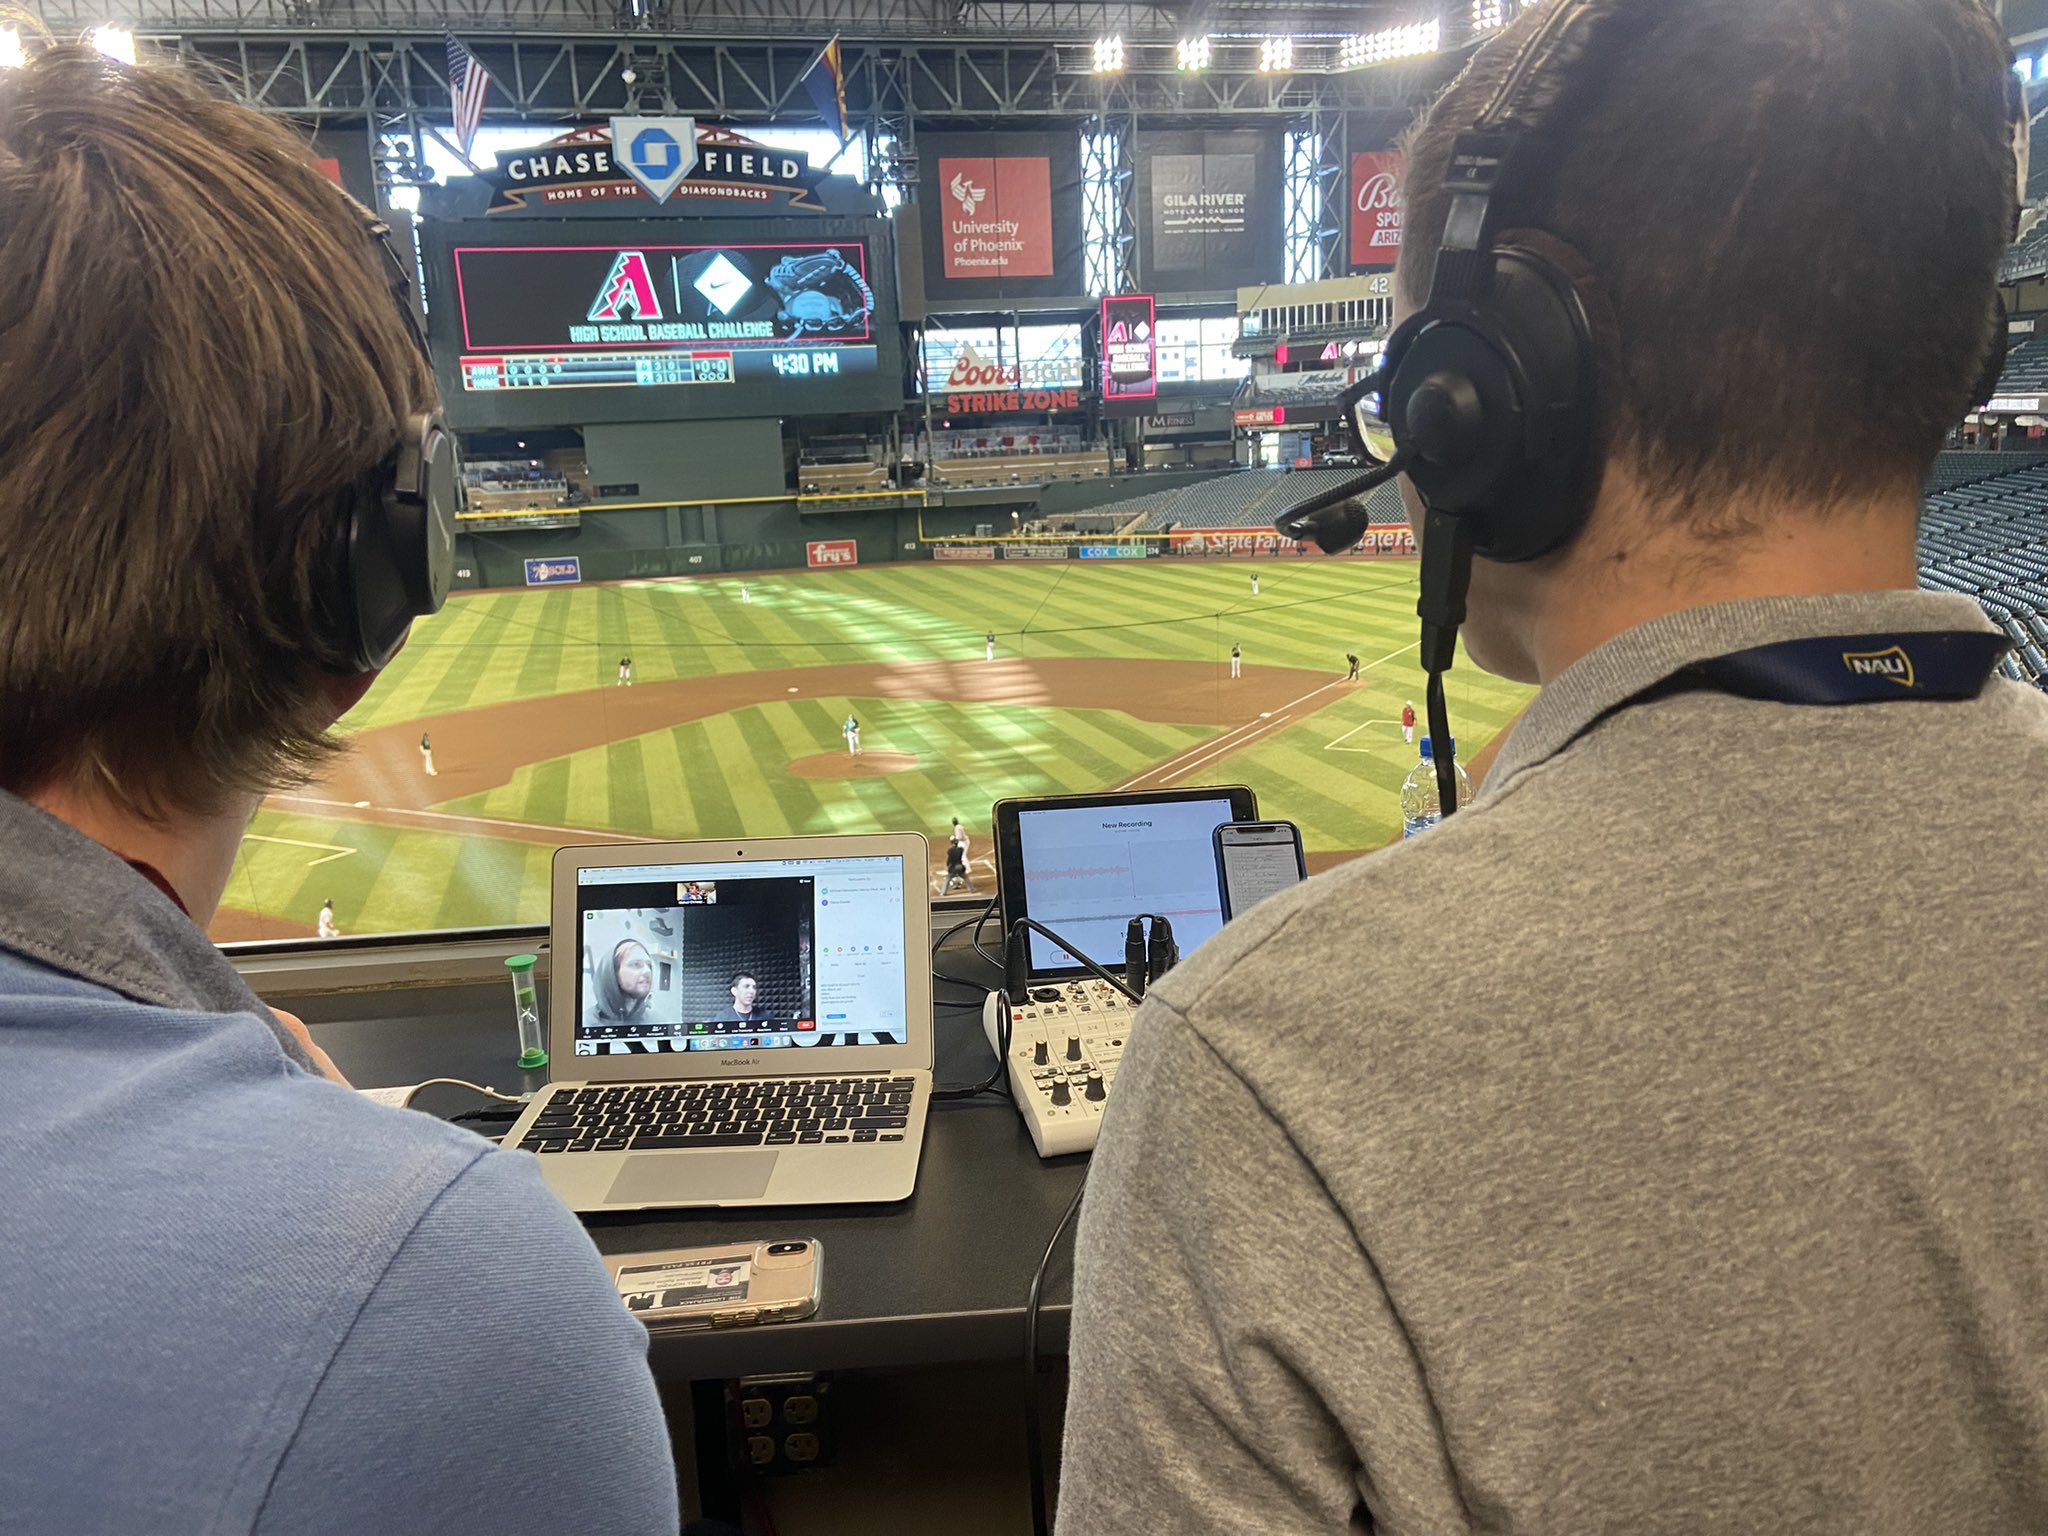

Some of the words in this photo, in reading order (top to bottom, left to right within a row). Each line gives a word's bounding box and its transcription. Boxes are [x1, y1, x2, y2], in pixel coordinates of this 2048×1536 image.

[508, 152, 609, 180] CHASE
[704, 152, 799, 179] FIELD
[547, 189, 583, 200] HOME
[590, 187, 606, 197] OF
[614, 186, 637, 195] THE
[680, 186, 768, 199] DIAMONDBACKS
[1163, 194, 1198, 206] GILA
[1200, 193, 1244, 206] RIVER
[1376, 212, 1402, 227] SPO
[953, 220, 1019, 237] University
[953, 239, 968, 252] of
[970, 238, 1023, 252] Phoenix
[1377, 231, 1401, 243] ARIZ
[954, 256, 1008, 266] Phoenix.edu
[1369, 277, 1389, 294] 42
[569, 326, 599, 342] HIGH
[602, 325, 647, 341] SCHOOL
[648, 324, 707, 340] BASEBALL
[708, 322, 774, 339] CHALLENGE
[470, 366, 498, 376] AWAY
[772, 353, 809, 374] 4:30
[812, 353, 839, 373] PM
[949, 357, 1020, 386] Coors
[1021, 361, 1085, 382] LIGHT
[947, 391, 1019, 414] STRIKE
[1022, 390, 1078, 410] ZONE
[1211, 533, 1252, 548] State
[1254, 532, 1297, 548] Farm
[812, 544, 851, 563] fry's
[1087, 548, 1109, 557] COX
[1116, 548, 1138, 557] COX
[1147, 547, 1159, 555] 374
[1853, 658, 1904, 674] NAU
[622, 1290, 666, 1311] LJ
